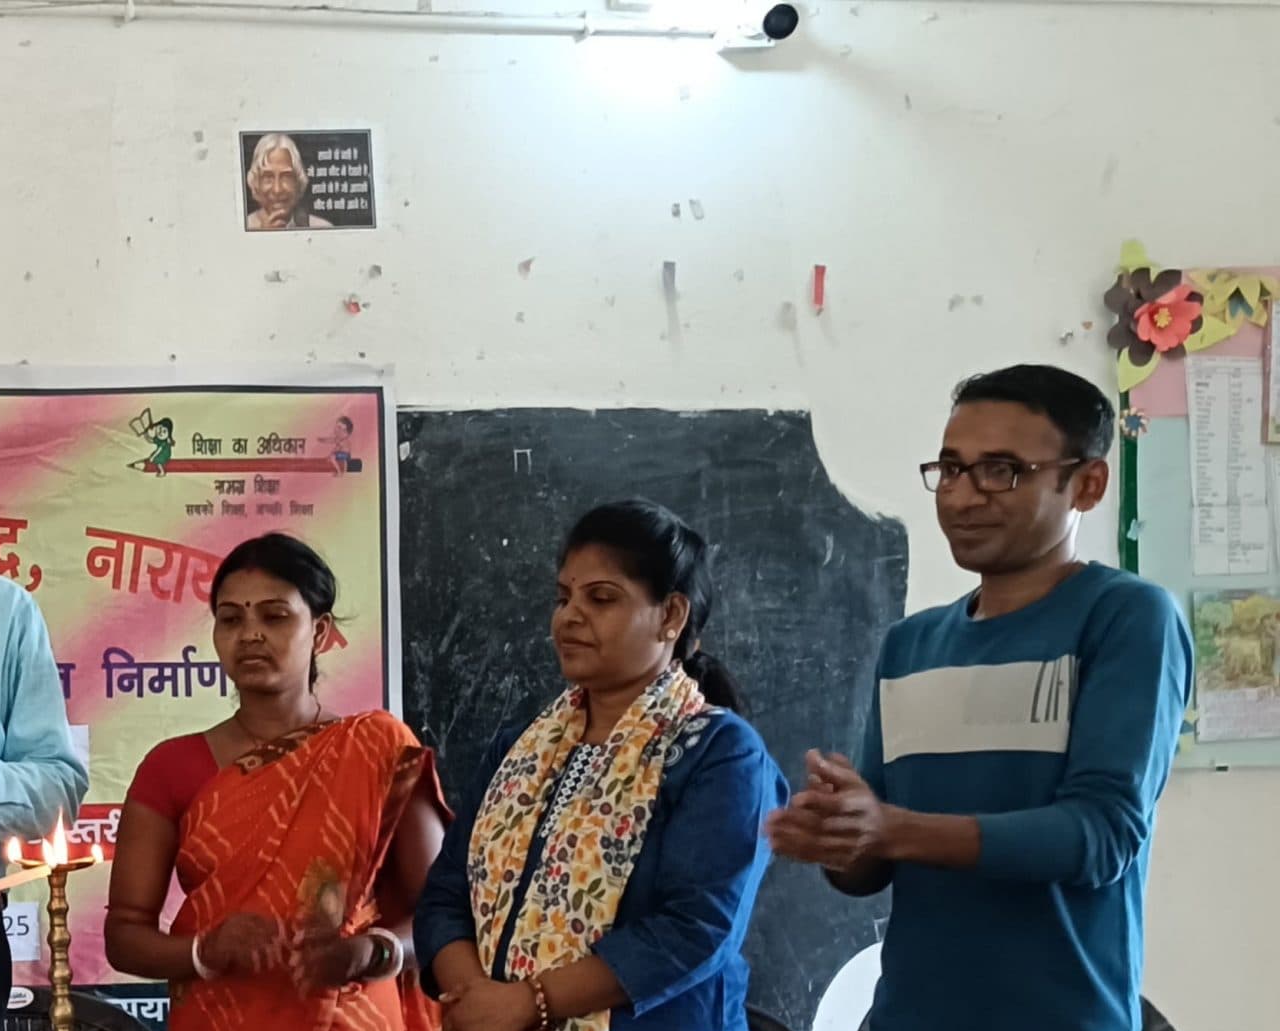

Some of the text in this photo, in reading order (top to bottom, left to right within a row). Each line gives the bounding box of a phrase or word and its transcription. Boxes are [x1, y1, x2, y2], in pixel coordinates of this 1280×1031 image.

[192, 432, 306, 455] शिक्षा का अधिकार
[254, 474, 280, 495] शिक्षा
[101, 645, 227, 699] निर्माण
[3, 915, 30, 936] 25
